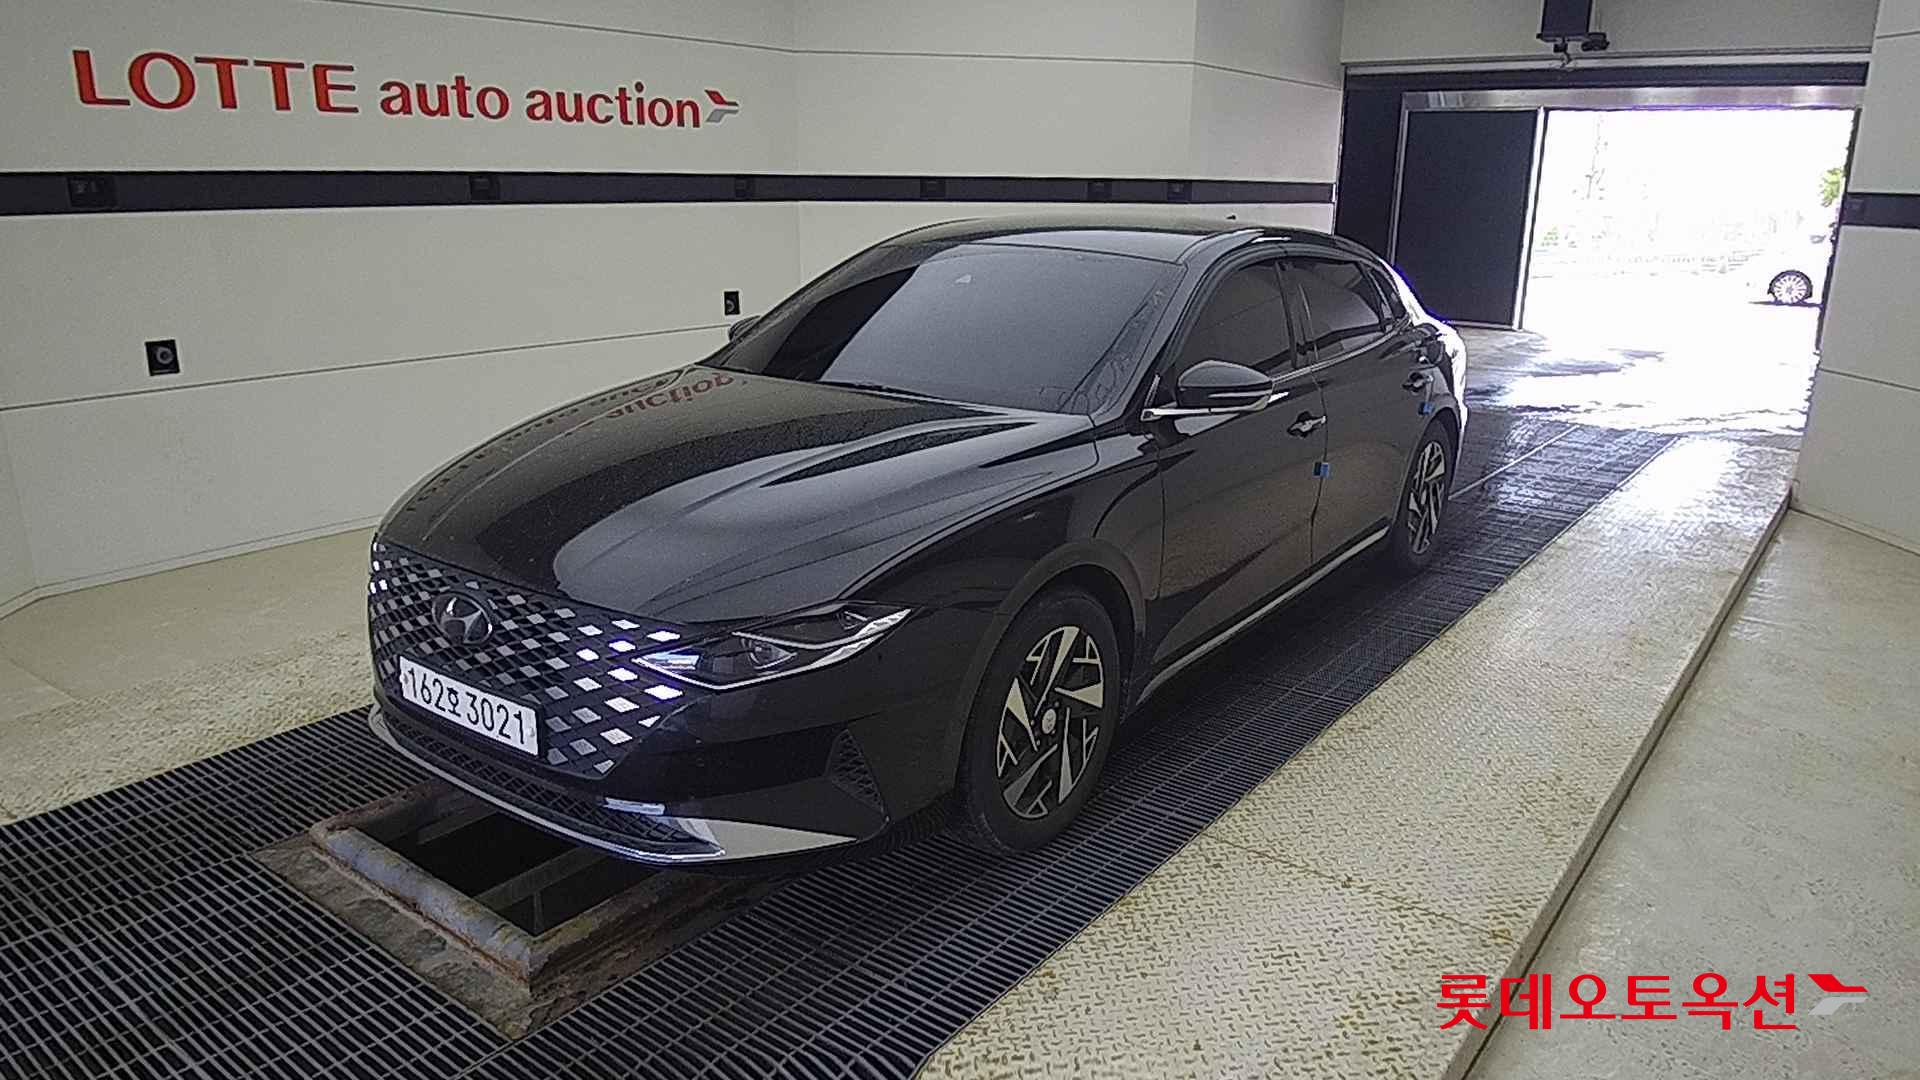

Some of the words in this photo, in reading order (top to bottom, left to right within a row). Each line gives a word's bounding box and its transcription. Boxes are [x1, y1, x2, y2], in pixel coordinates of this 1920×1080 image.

[72, 49, 360, 114] LOTTE
[379, 76, 510, 120] auto
[525, 81, 701, 129] auction
[465, 691, 525, 745] 3021
